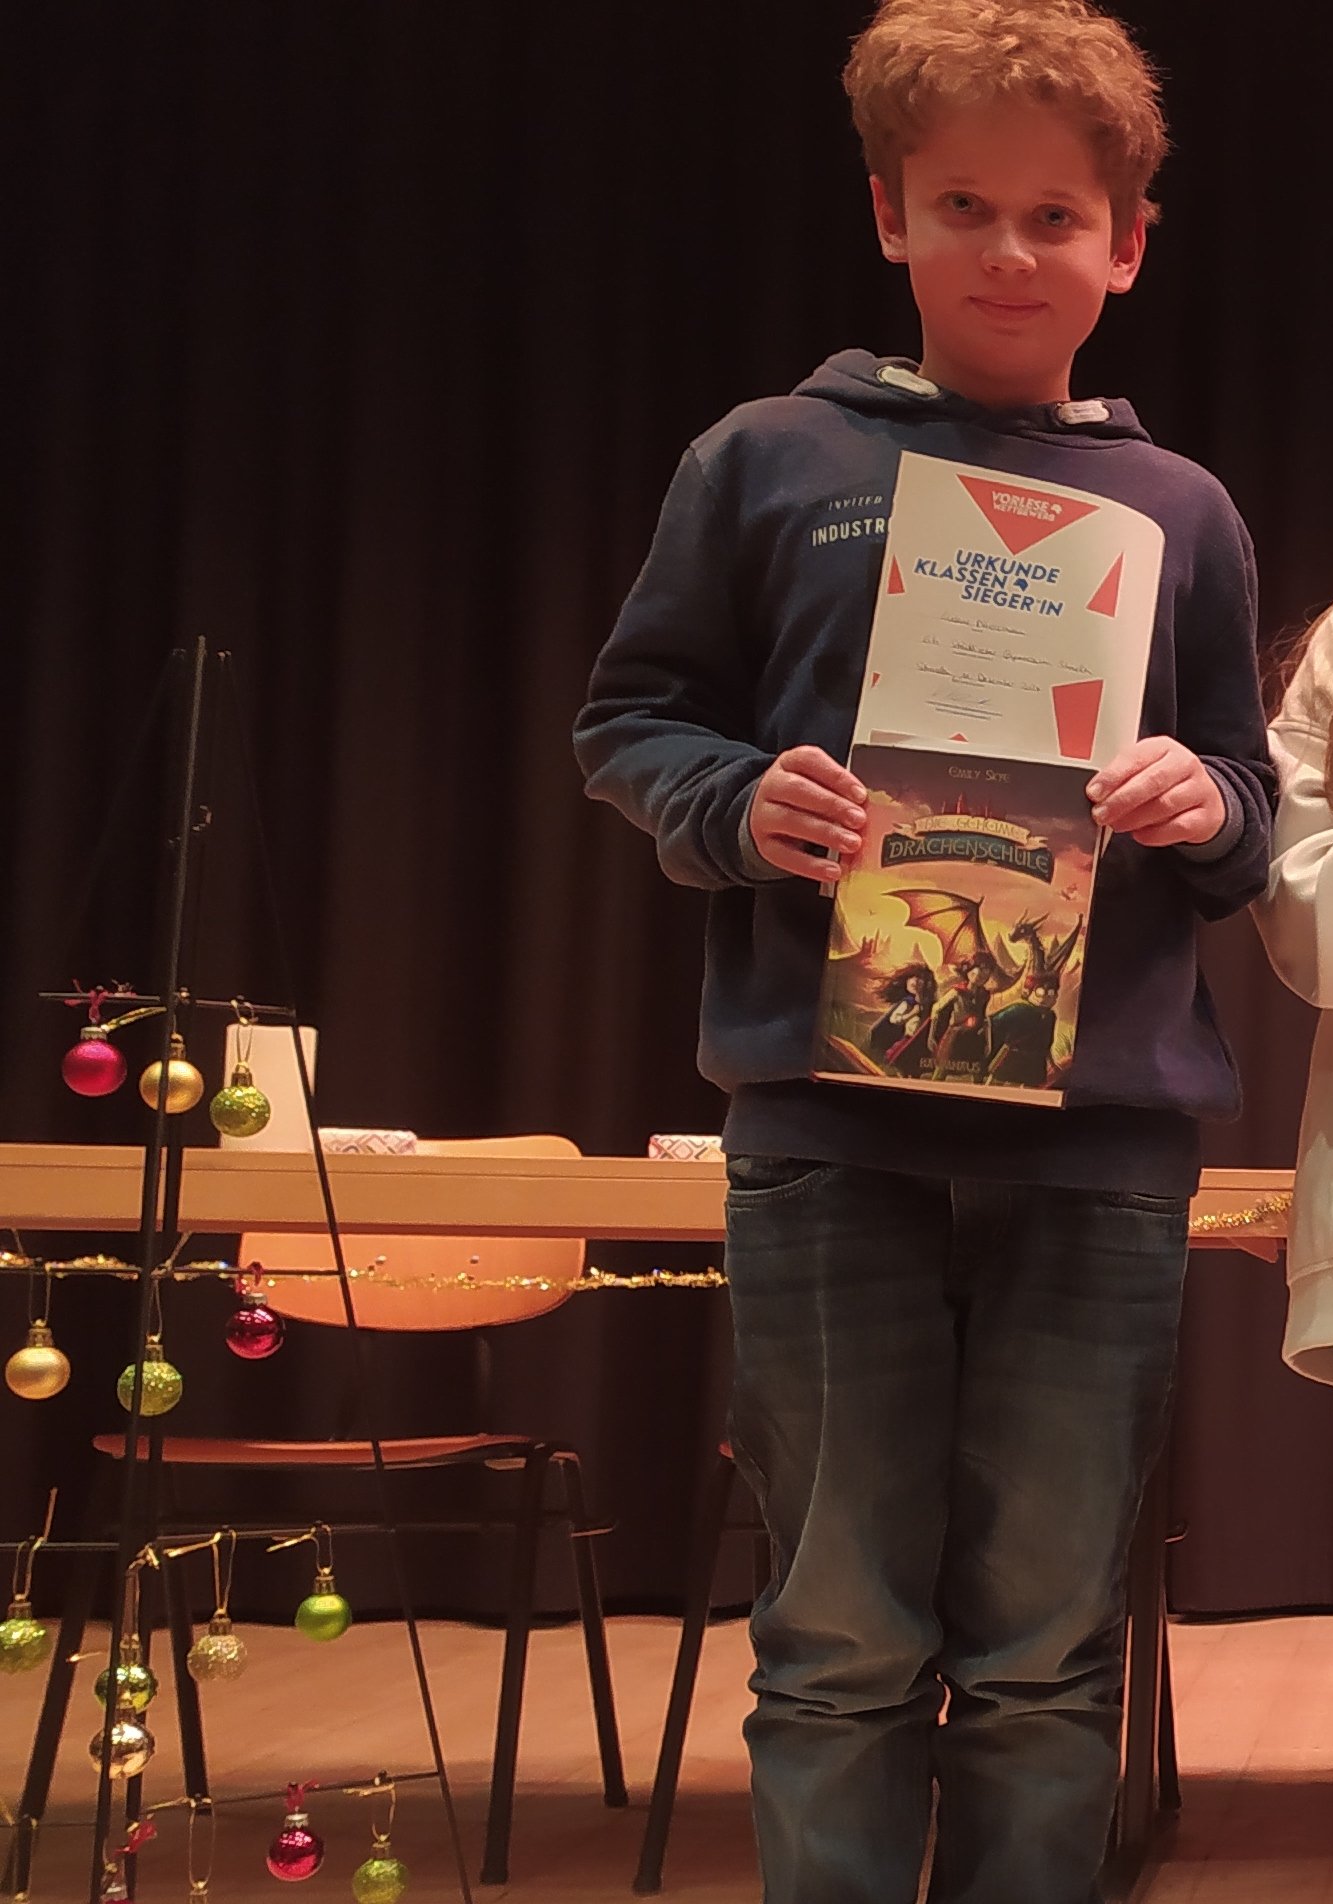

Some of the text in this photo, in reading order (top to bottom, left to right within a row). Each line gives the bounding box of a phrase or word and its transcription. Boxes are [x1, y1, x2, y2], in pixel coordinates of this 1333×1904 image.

[992, 491, 1049, 511] VORLESE
[812, 517, 892, 547] INDUSTR
[914, 558, 1008, 589] KLASSEN
[956, 549, 1060, 583] URKUNDE
[889, 837, 1048, 873] DRACHENSCHULE
